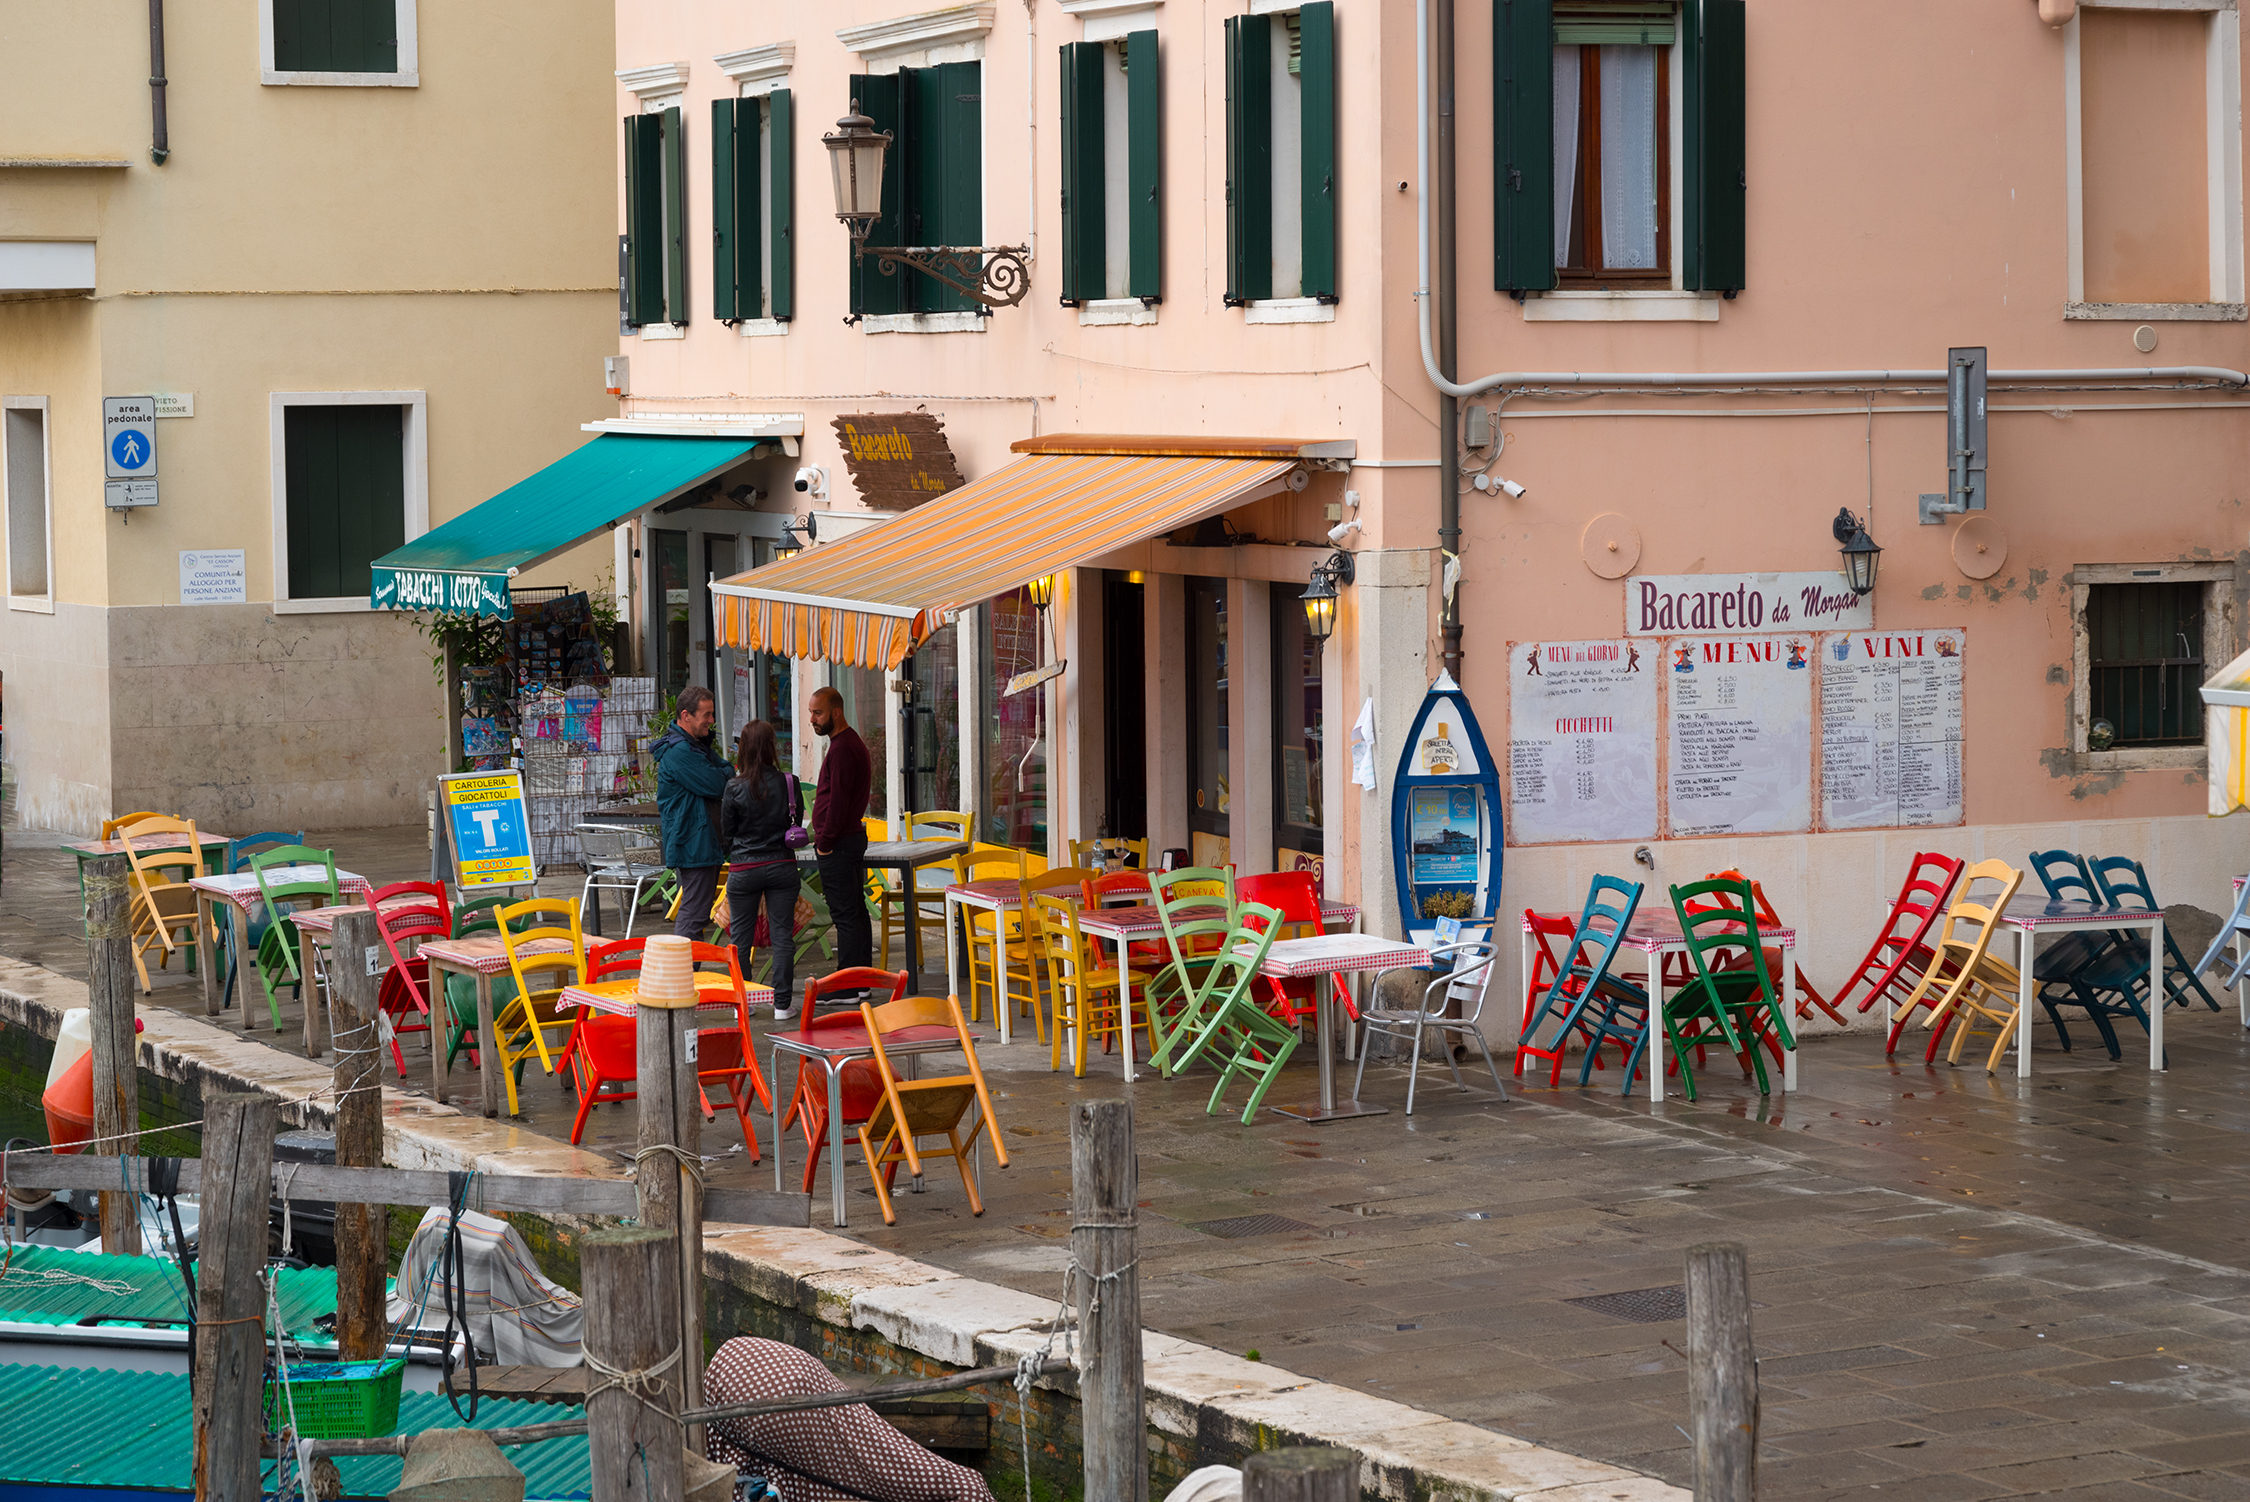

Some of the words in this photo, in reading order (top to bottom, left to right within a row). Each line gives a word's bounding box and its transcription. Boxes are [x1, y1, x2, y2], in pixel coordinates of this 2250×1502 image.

[108, 414, 152, 424] pedonale
[845, 424, 913, 461] Bacareto
[194, 570, 231, 578] COMUNITÀ
[395, 572, 444, 606] TABACCHI
[450, 575, 480, 609] LOTTO
[1639, 581, 1763, 631] Bacareto
[1772, 596, 1791, 624] da
[1801, 585, 1860, 622] Morgan
[1548, 646, 1573, 663] MENU
[1587, 644, 1619, 662] GIORNO
[1703, 641, 1781, 664] MENU
[1863, 636, 1925, 658] VINI
[1556, 716, 1613, 734] CICCHETTI
[455, 778, 507, 790] CARTOLERIA
[459, 790, 508, 802] GIOCATTOLI
[1416, 804, 1424, 814] €
[472, 809, 500, 847] T
